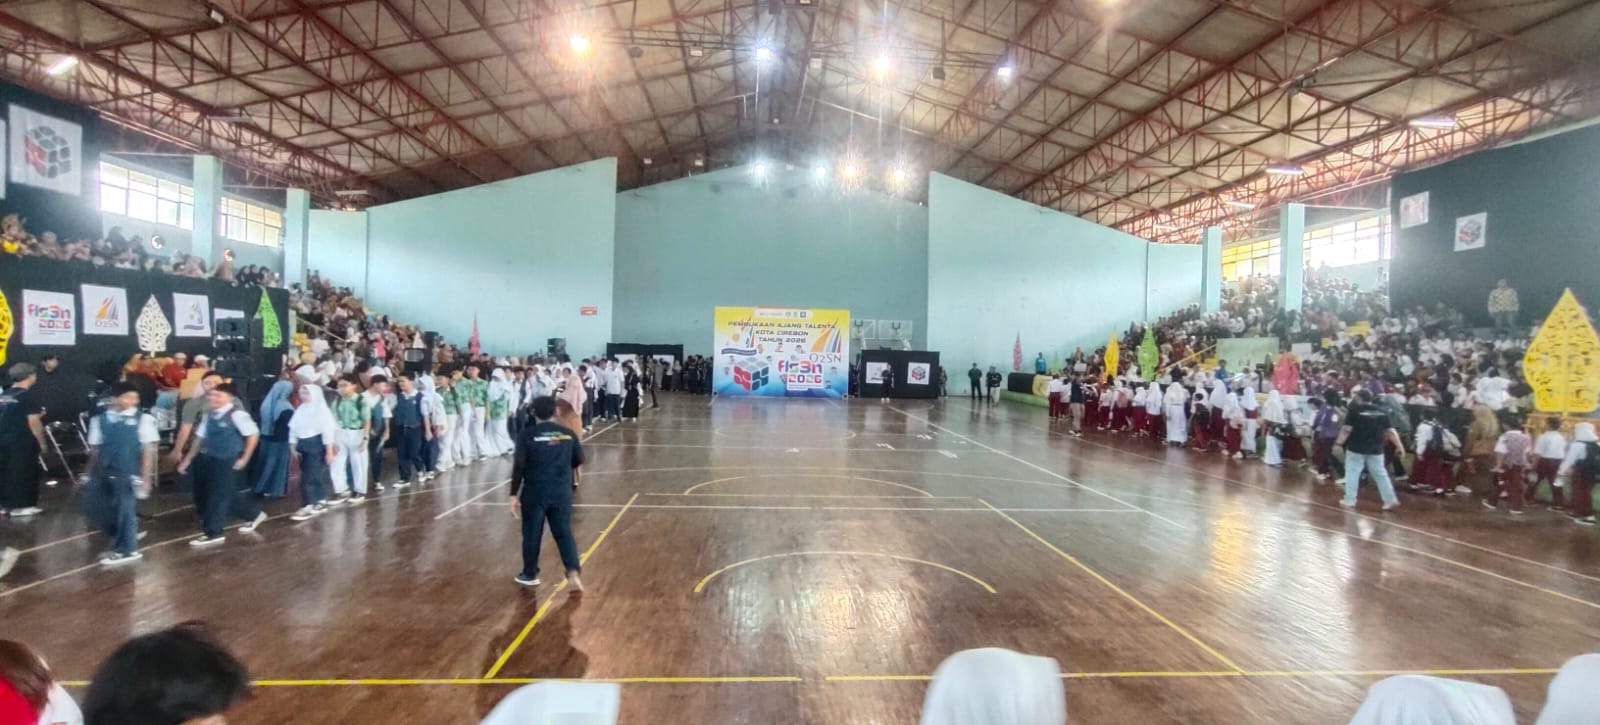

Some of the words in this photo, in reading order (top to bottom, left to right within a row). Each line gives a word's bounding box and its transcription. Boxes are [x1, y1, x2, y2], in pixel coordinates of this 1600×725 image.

[39, 319, 71, 329] 2026
[809, 352, 842, 363] O2SN
[788, 374, 822, 383] 2026
